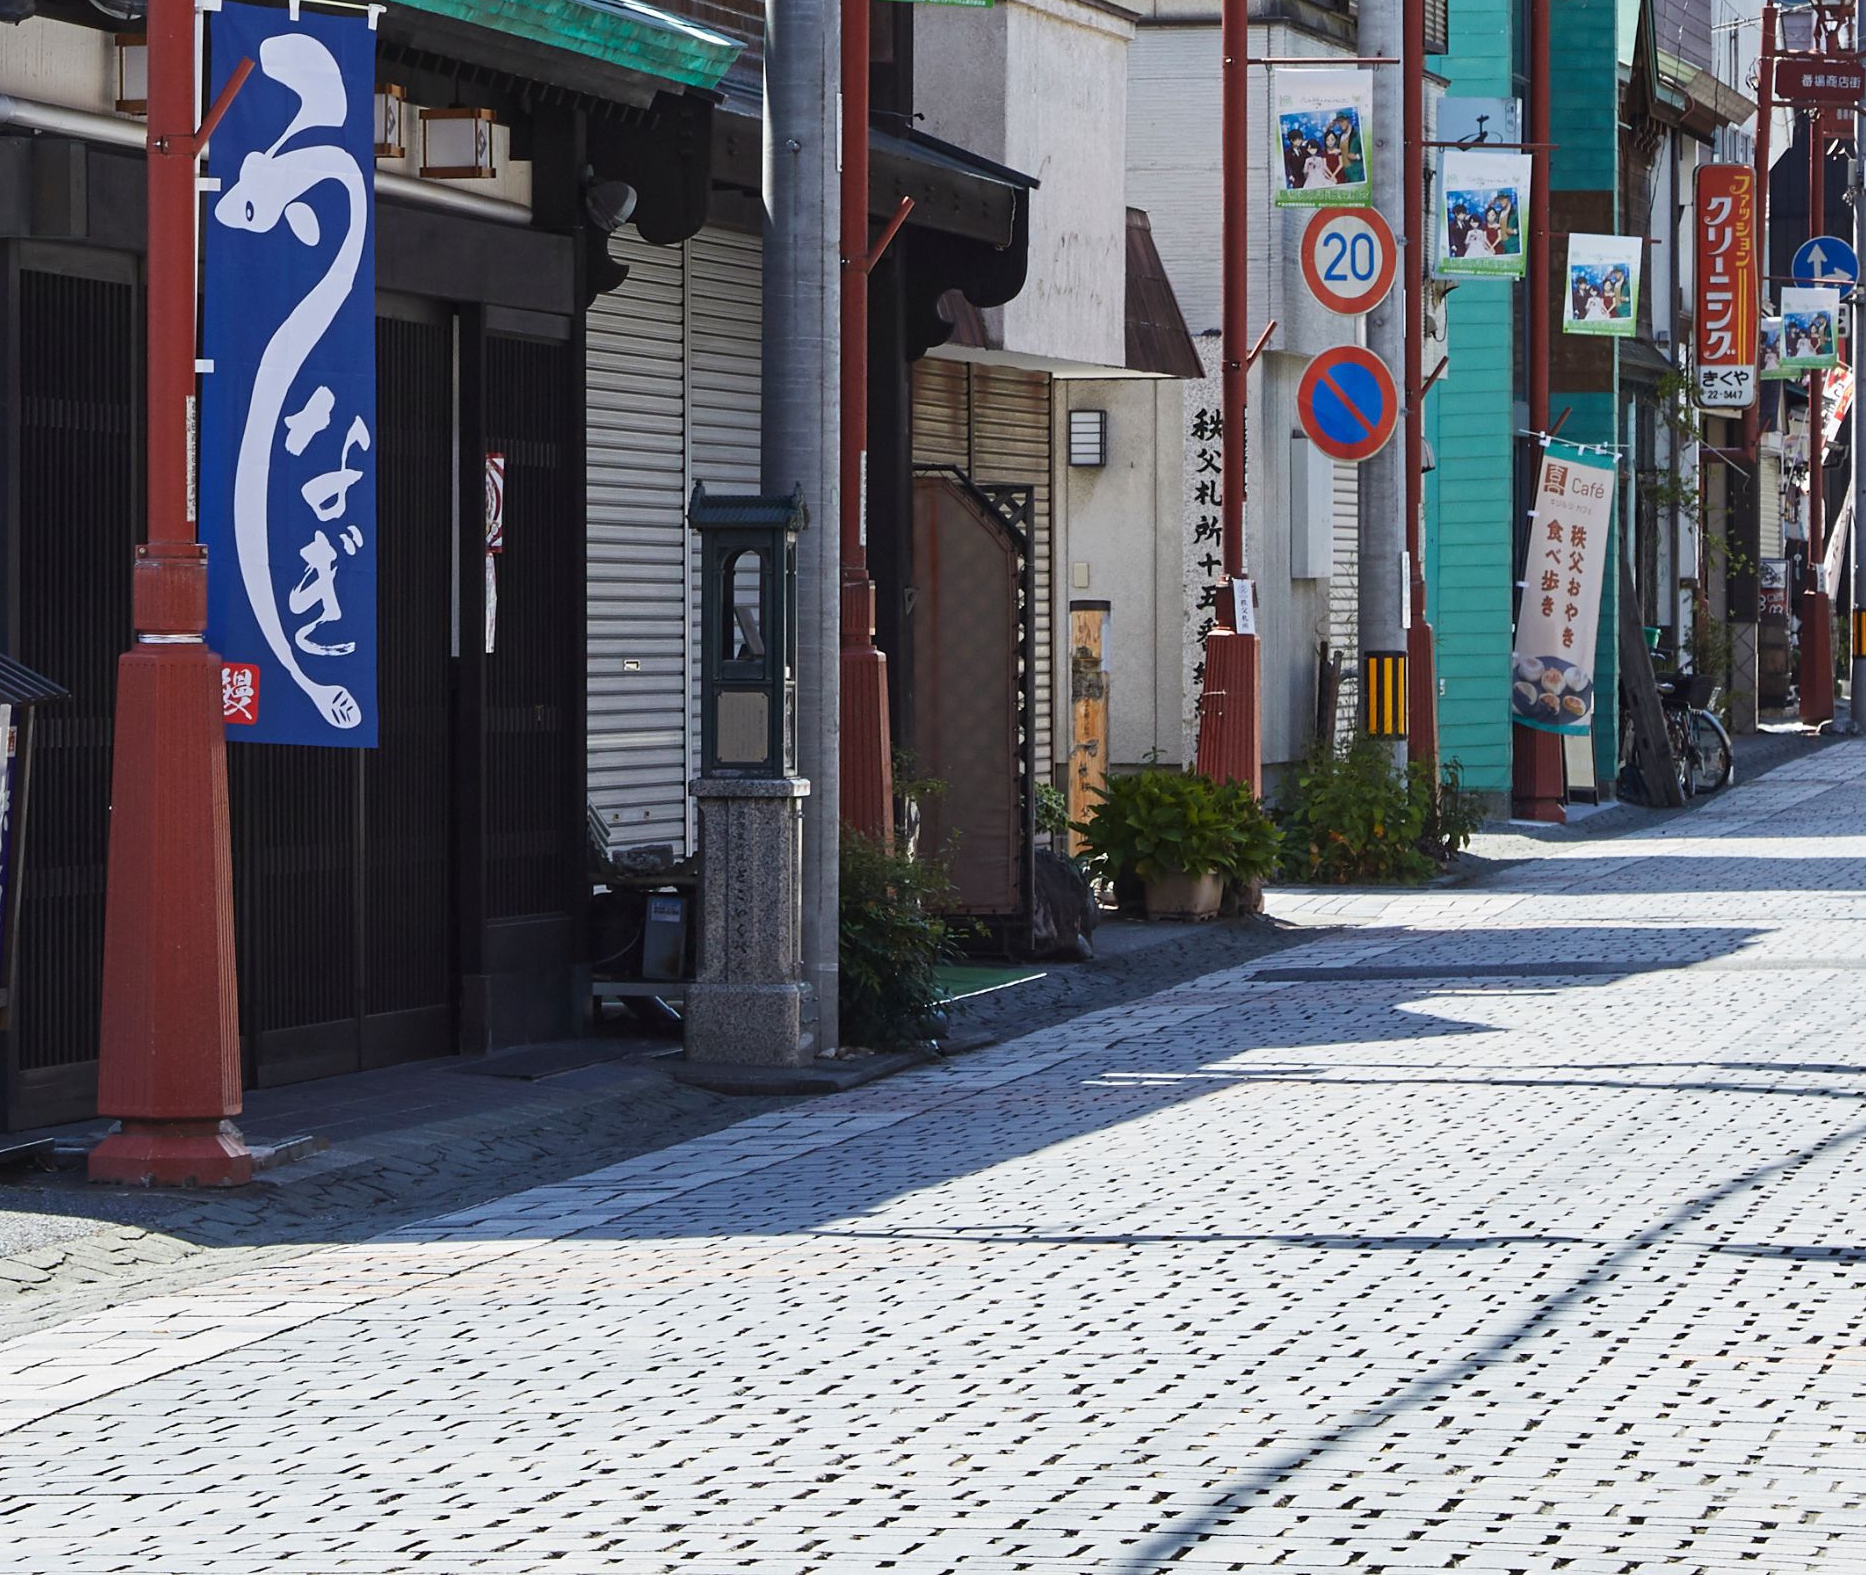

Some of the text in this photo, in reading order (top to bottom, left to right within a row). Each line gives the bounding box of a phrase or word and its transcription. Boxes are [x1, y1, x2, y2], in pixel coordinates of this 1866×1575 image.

[1802, 75, 1861, 90] 番場商店街
[1730, 175, 1750, 267] ファッション
[1323, 232, 1375, 282] 20
[1703, 196, 1736, 360] クリーニング
[1702, 370, 1749, 387] きくや
[1707, 390, 1743, 400] 22-5447
[1572, 478, 1605, 499] Café
[1540, 518, 1564, 618] 食べ歩き
[1561, 524, 1587, 649] 秩父おやき
